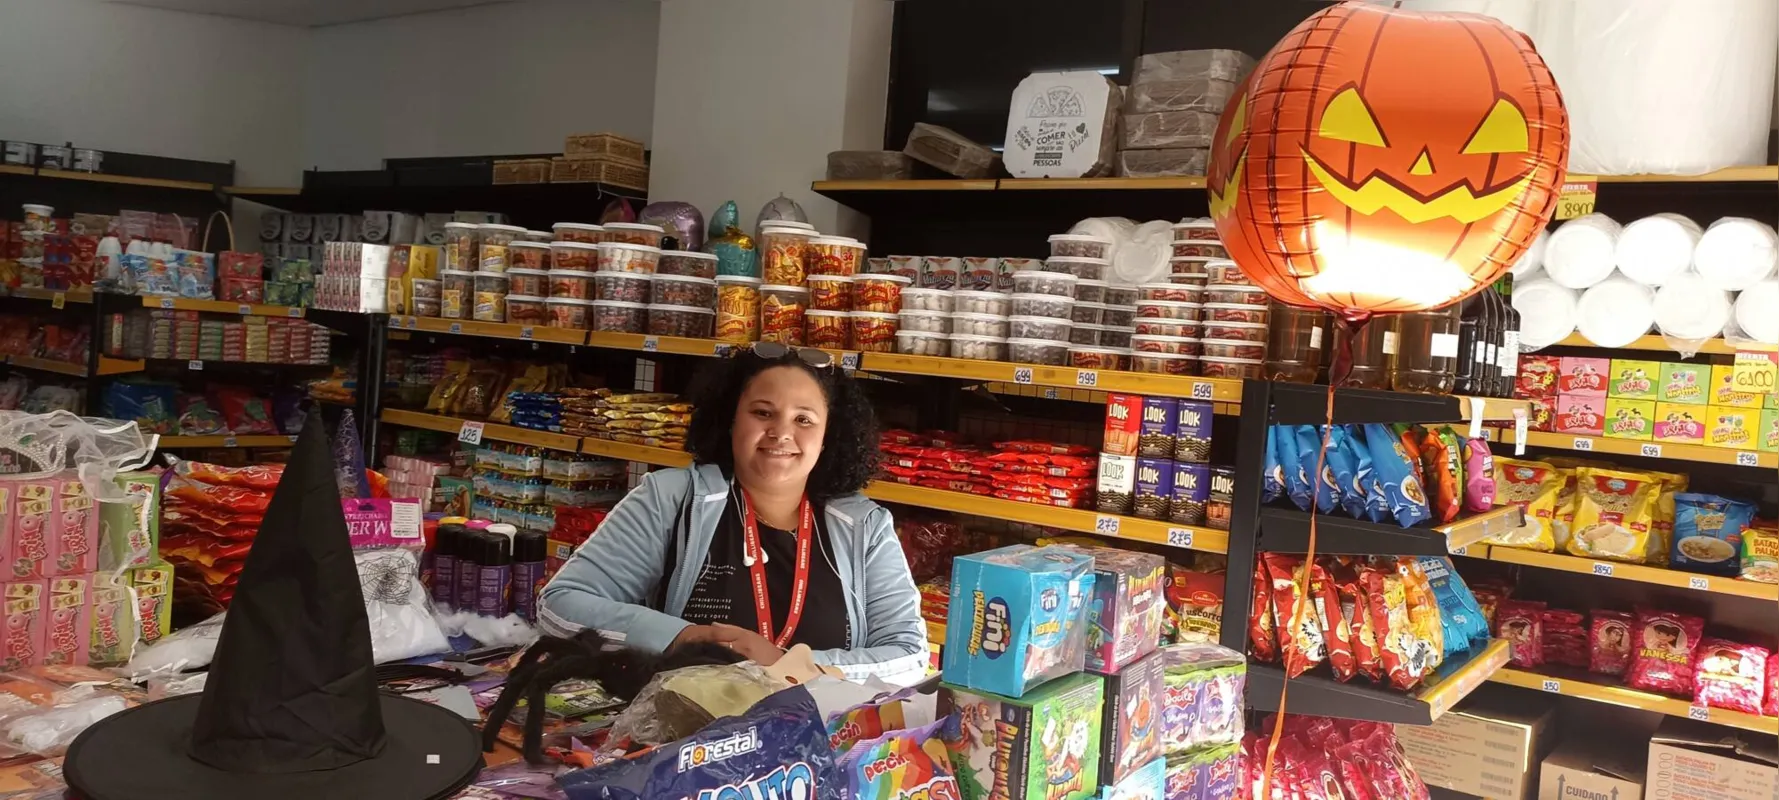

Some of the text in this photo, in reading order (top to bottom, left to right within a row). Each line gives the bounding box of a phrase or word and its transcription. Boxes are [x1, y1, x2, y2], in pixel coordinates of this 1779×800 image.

[1037, 131, 1066, 145] COMER
[1014, 370, 1031, 382] 699
[1078, 373, 1096, 385] 599
[1193, 385, 1212, 398] 599
[1109, 403, 1129, 420] LOOK
[1144, 406, 1166, 423] LOOK
[1180, 409, 1201, 427] LOOK
[460, 428, 477, 442] 125
[1575, 440, 1590, 449] 699
[1642, 446, 1659, 457] 699
[1101, 462, 1124, 480] LOOK
[1139, 466, 1159, 484] LOOK
[1175, 471, 1197, 489] LOOK
[1211, 475, 1234, 494] LOOK
[967, 590, 985, 656] DENTADURAS
[1639, 649, 1688, 665] VANESSA
[1690, 708, 1709, 720] 299
[677, 726, 758, 773] Florestal
